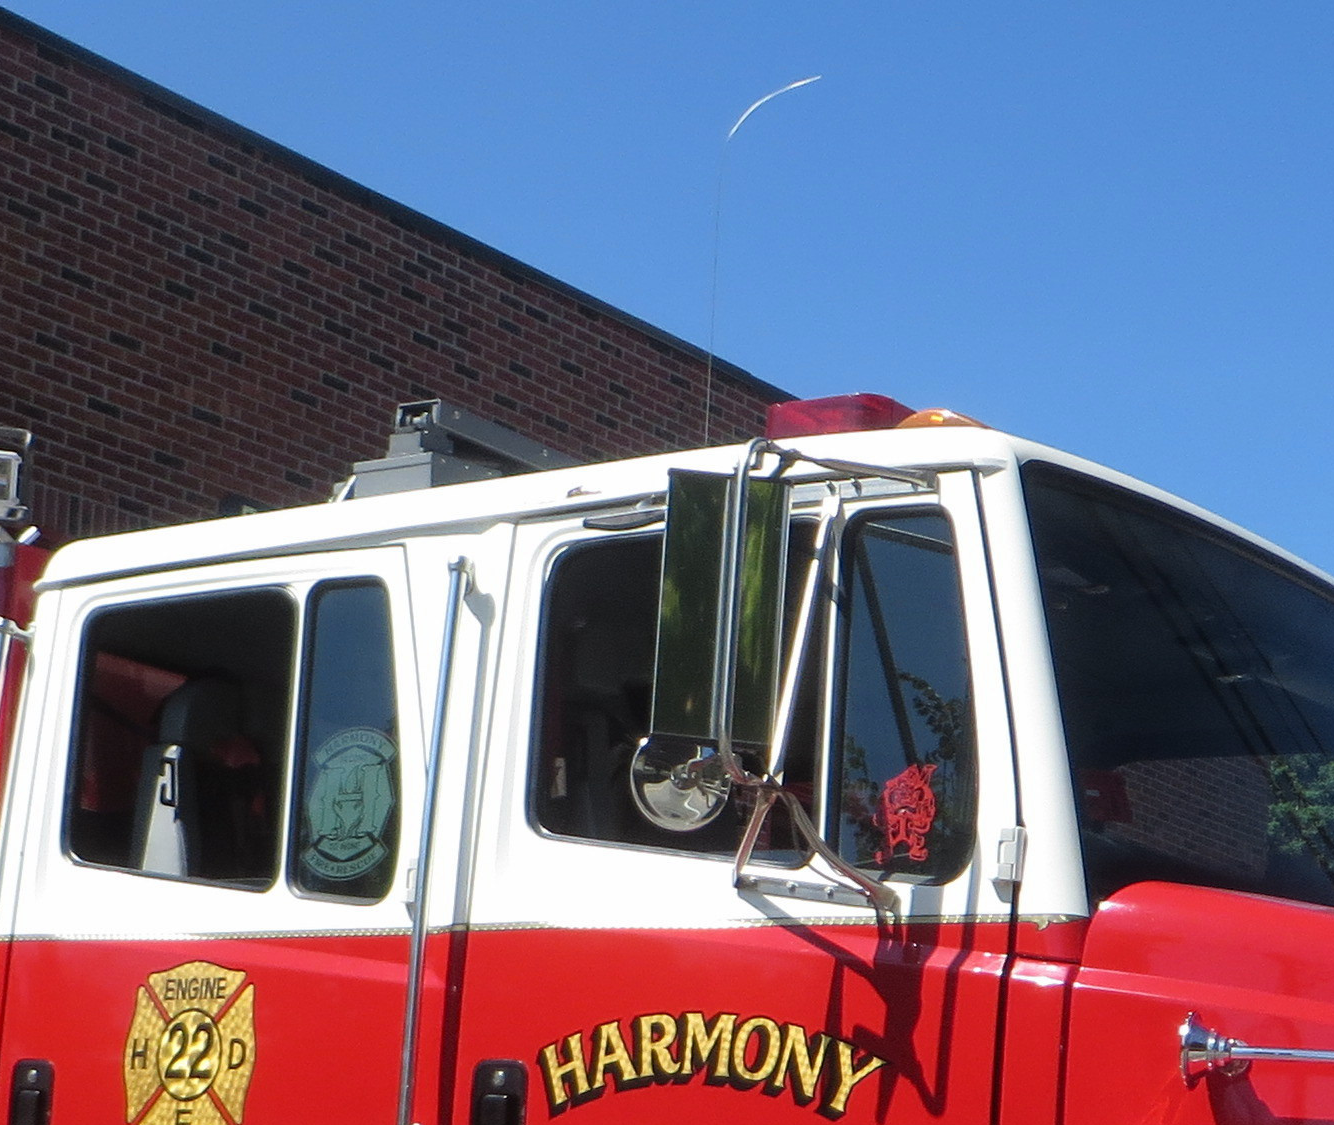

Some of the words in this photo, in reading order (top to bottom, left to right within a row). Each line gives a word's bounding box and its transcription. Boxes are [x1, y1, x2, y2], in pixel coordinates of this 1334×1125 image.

[324, 731, 387, 755] HARMONY
[335, 849, 380, 876] RESCUE
[163, 976, 228, 1001] ENGINE
[129, 1037, 150, 1070] H
[163, 1021, 215, 1080] 22
[227, 1036, 248, 1071] D
[539, 1012, 887, 1117] HARMONY
